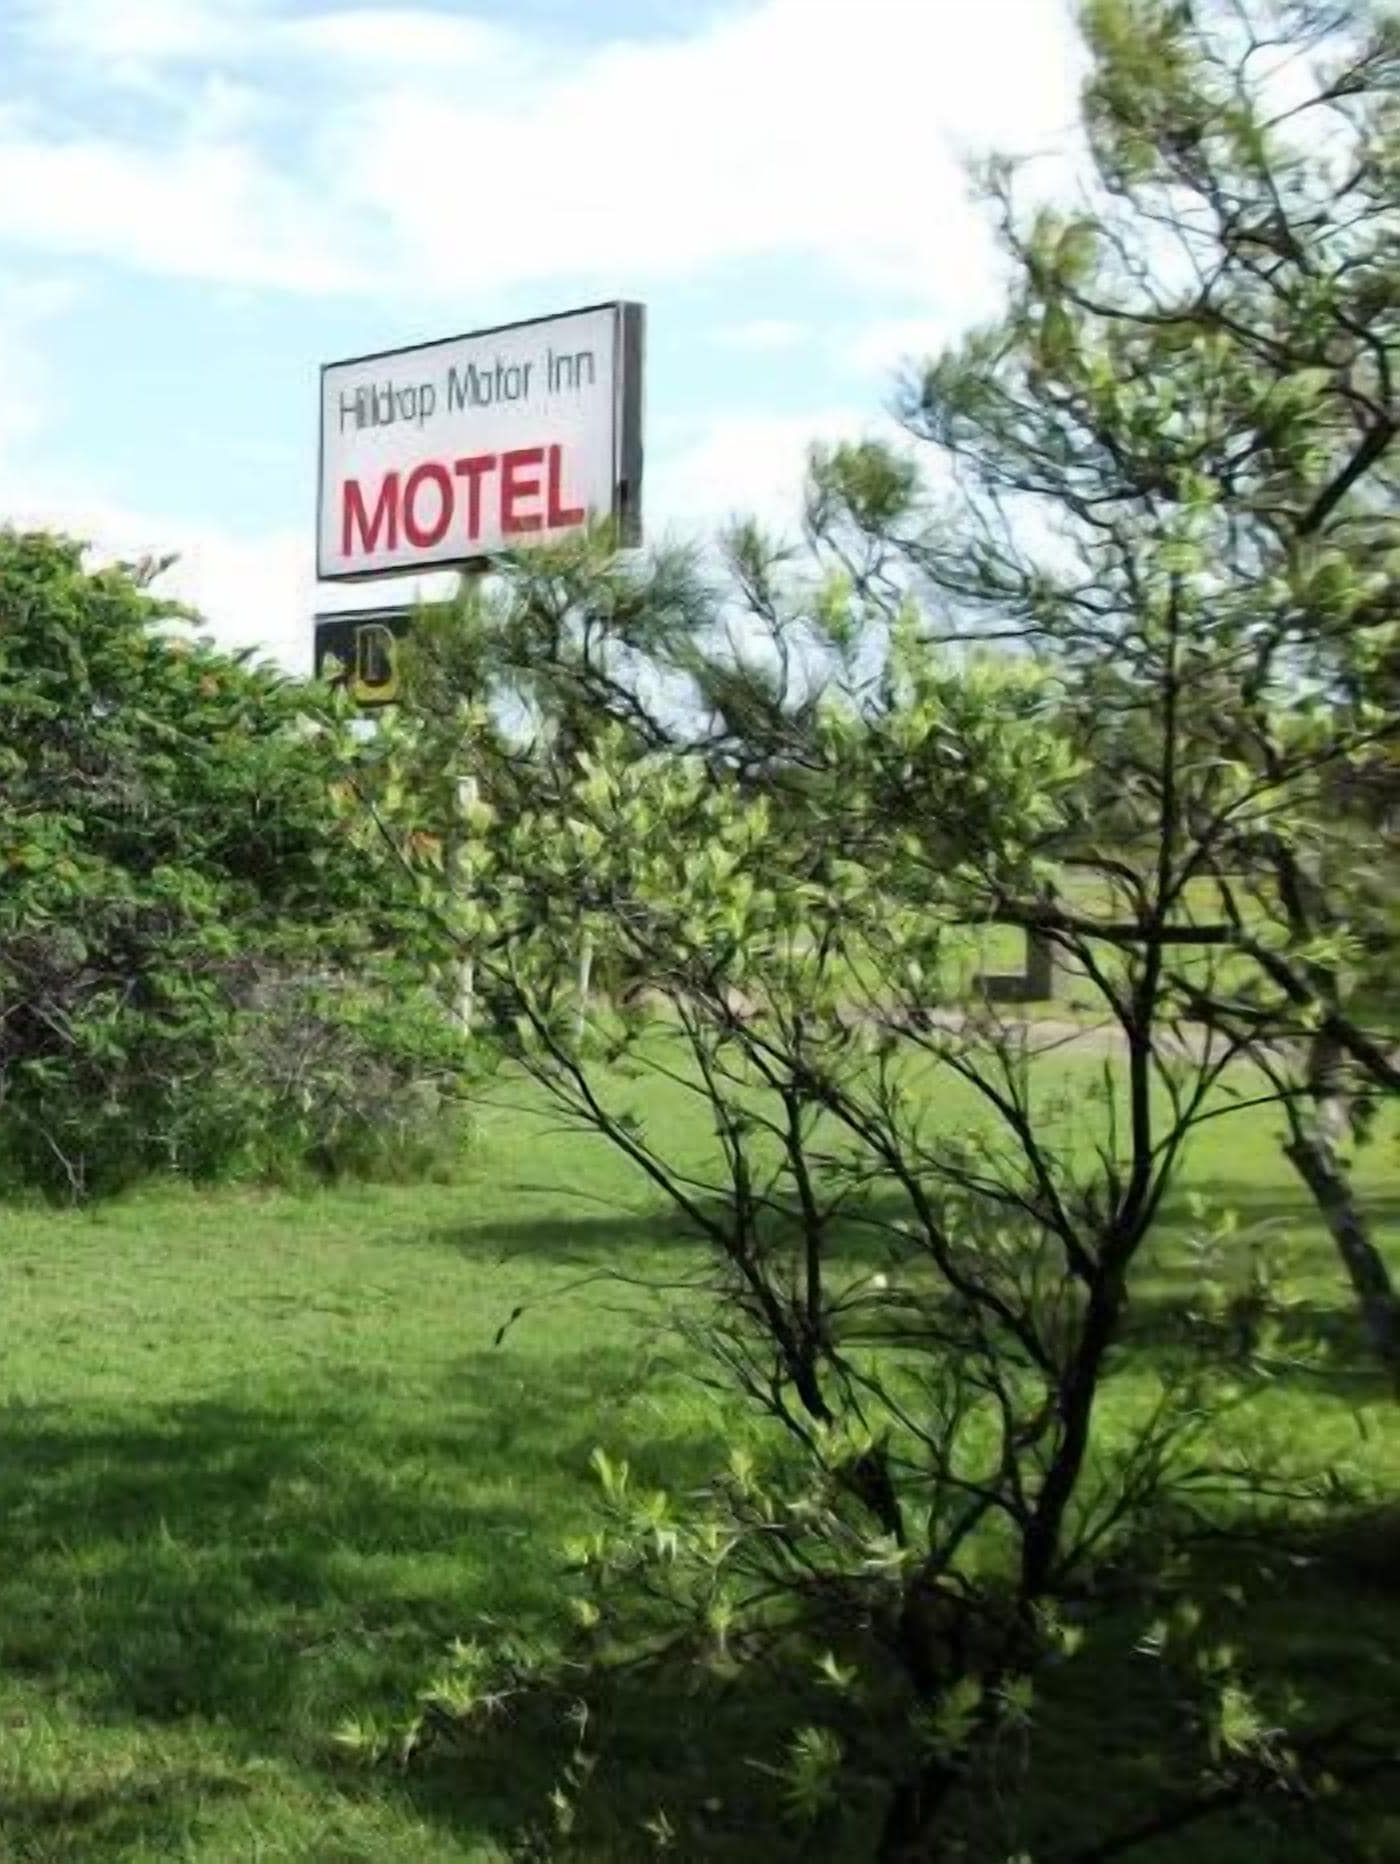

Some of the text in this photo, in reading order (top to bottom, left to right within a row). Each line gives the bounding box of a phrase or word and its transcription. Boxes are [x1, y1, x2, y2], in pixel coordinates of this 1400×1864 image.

[447, 356, 532, 412] Motor
[547, 347, 596, 394] Inn
[341, 444, 586, 558] MOTEL
